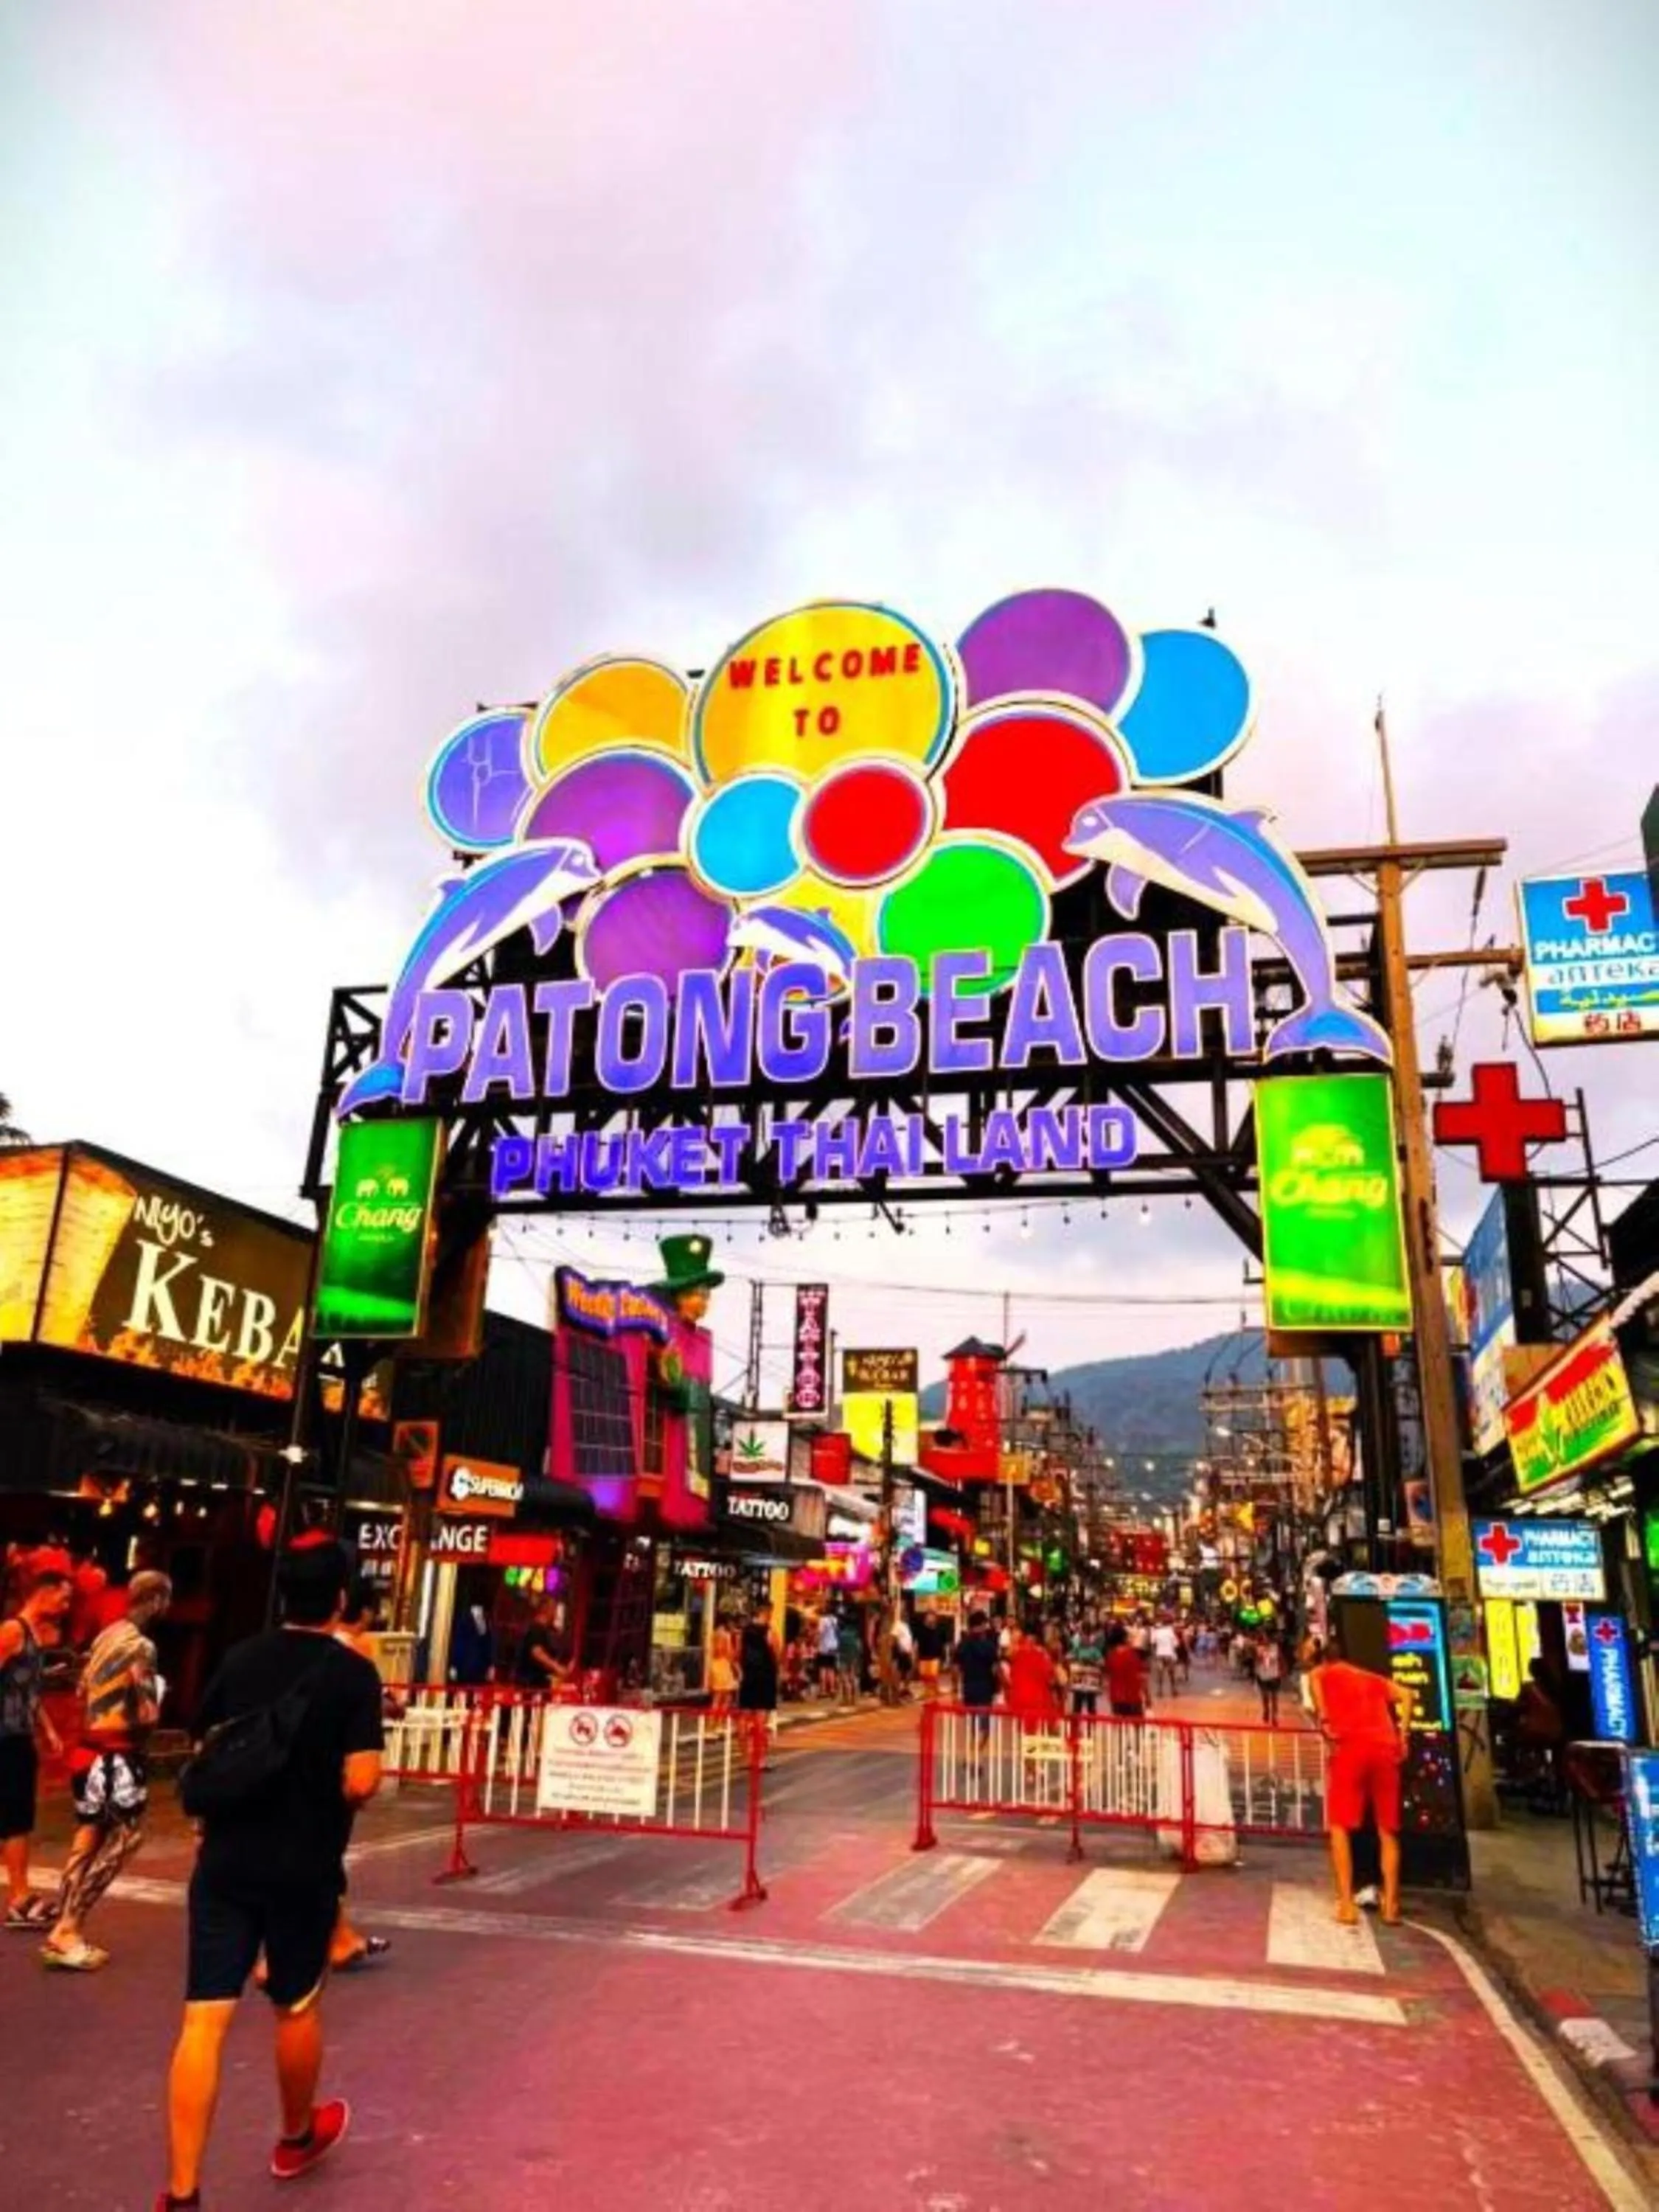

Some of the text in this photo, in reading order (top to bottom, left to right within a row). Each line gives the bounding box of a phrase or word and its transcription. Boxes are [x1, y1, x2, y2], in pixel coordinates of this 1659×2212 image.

[729, 643, 919, 688] WELCOME
[793, 706, 840, 737] TO
[1534, 932, 1656, 959] PHARMAC
[402, 927, 1255, 1104] PATONG BEACH
[490, 1124, 750, 1194] PHUKET
[1270, 1169, 1388, 1208] Chang
[335, 1203, 422, 1232] Chang
[727, 1496, 789, 1521] TATTOO
[358, 1523, 488, 1552] EXCNGE
[673, 1559, 737, 1580] TATTOO
